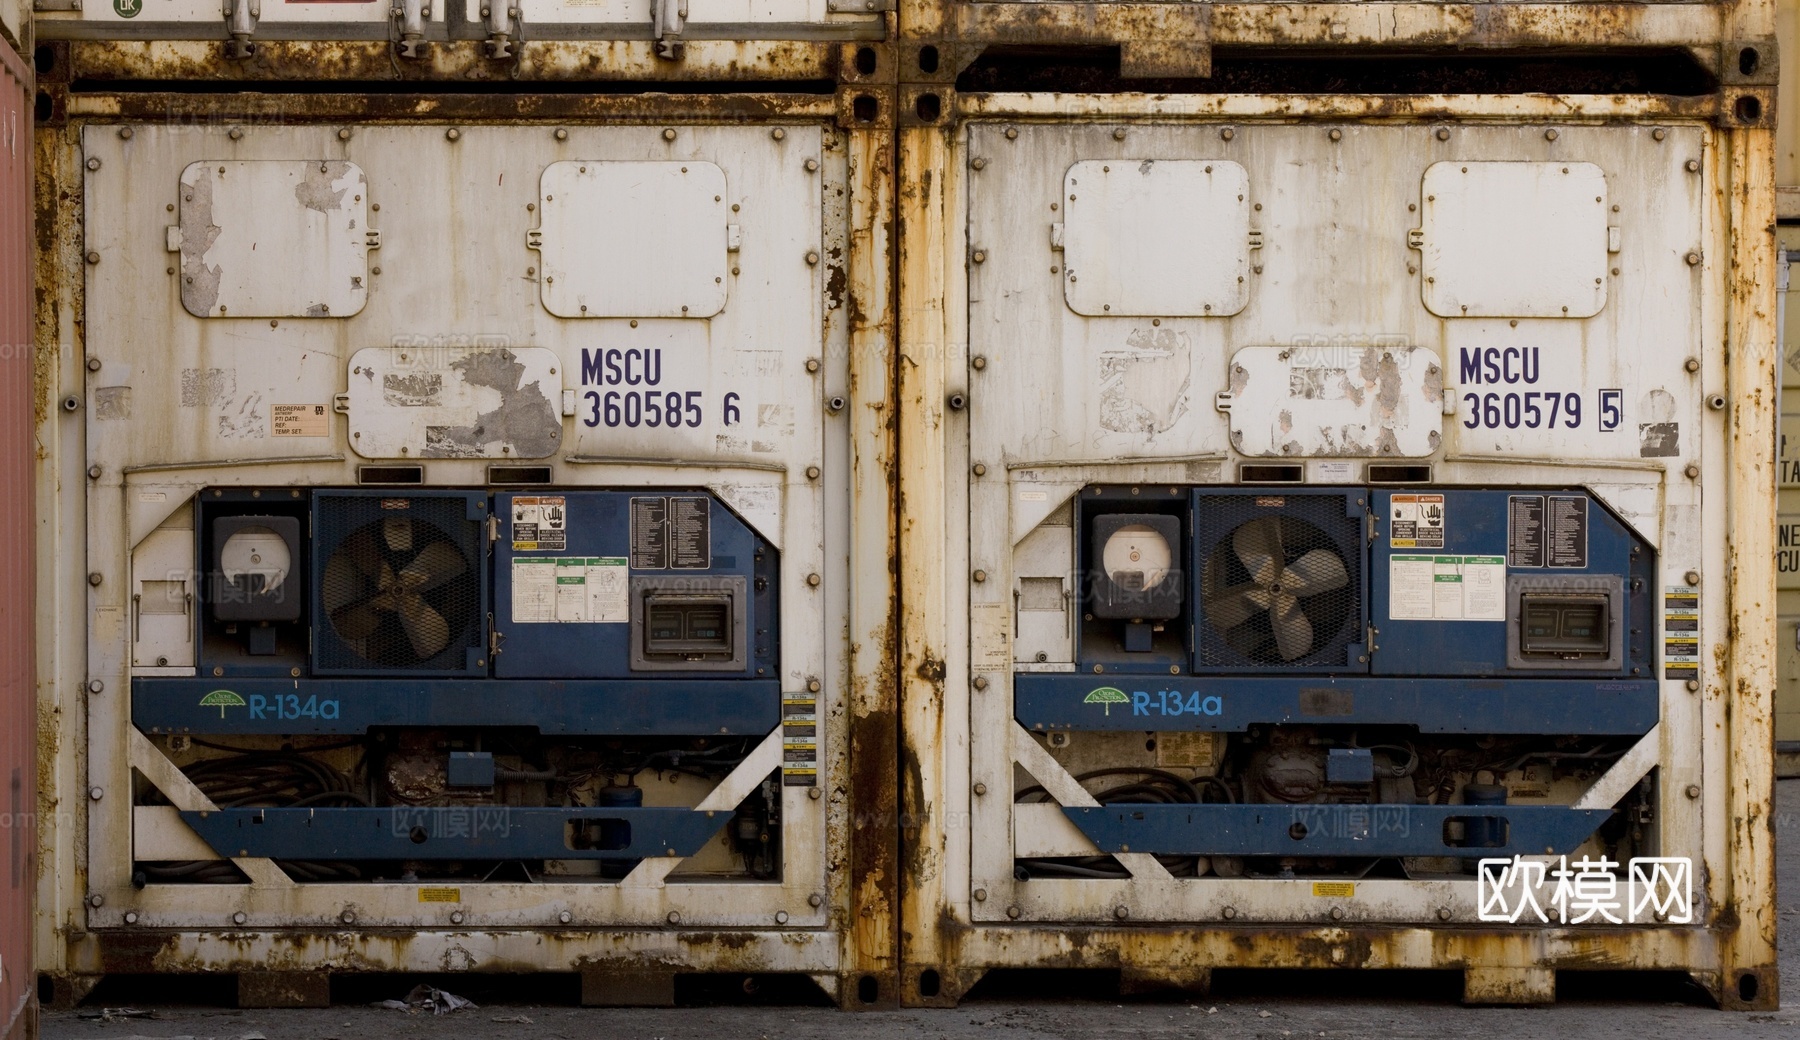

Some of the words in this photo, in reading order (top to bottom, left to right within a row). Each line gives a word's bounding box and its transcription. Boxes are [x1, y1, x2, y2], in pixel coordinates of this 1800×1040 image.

[119, 0, 136, 10] OK
[581, 347, 662, 386] MSCU
[1459, 347, 1540, 385] MSCU
[583, 391, 703, 428] 360585
[723, 391, 741, 427] 6
[1463, 391, 1582, 429] 360579
[1602, 391, 1620, 429] 5
[249, 694, 340, 719] R-134a
[1133, 690, 1222, 716] R-134a
